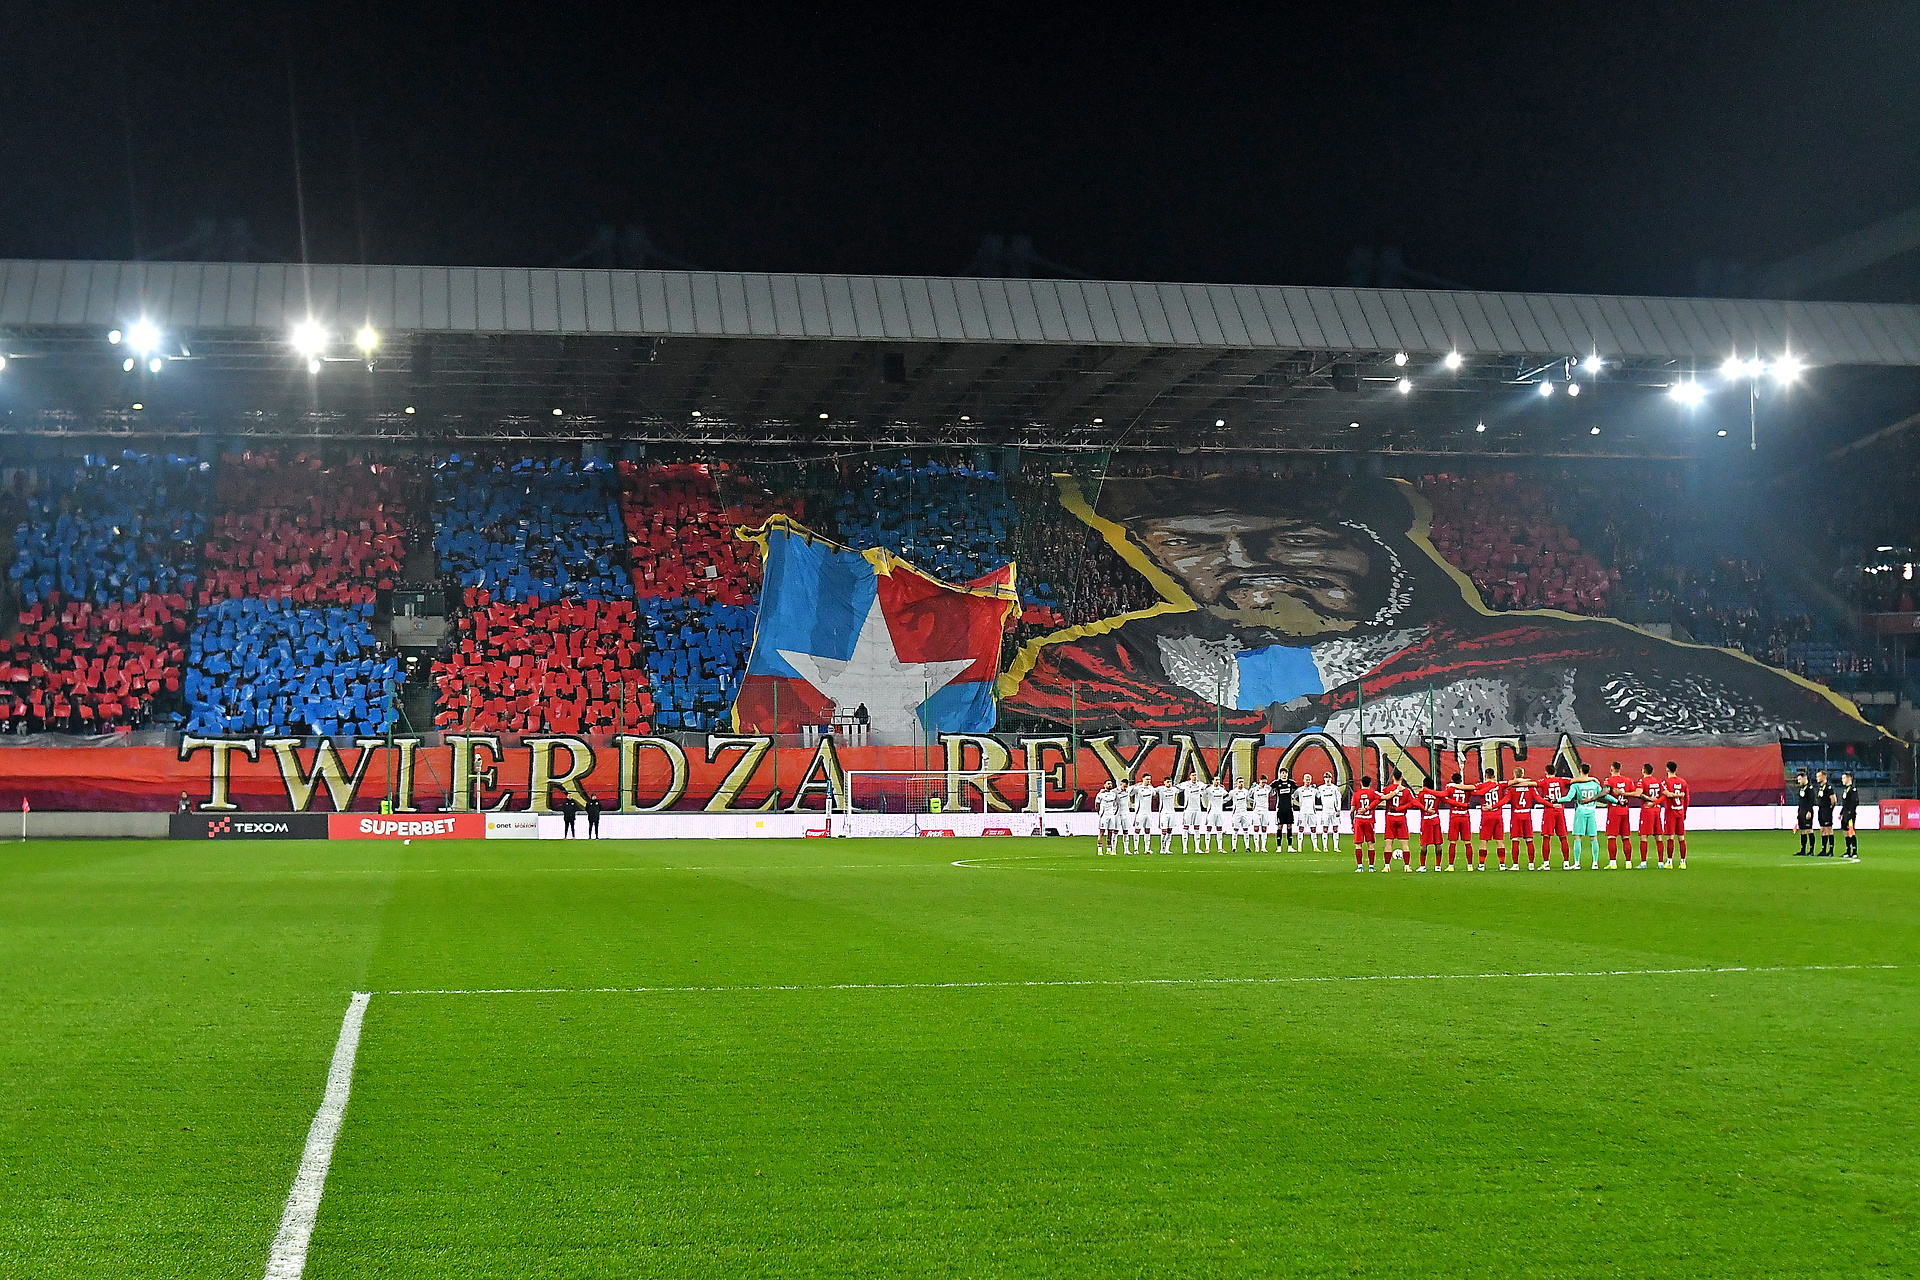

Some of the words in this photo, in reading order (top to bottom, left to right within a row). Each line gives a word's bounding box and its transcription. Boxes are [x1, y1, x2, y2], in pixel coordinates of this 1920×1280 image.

[177, 733, 865, 814] TWIERDZA
[937, 731, 1608, 814] REYMONTA
[1485, 792, 1499, 811] 99
[1519, 792, 1526, 807] 4
[234, 822, 289, 833] TEXOM
[359, 818, 456, 836] SUPERBET
